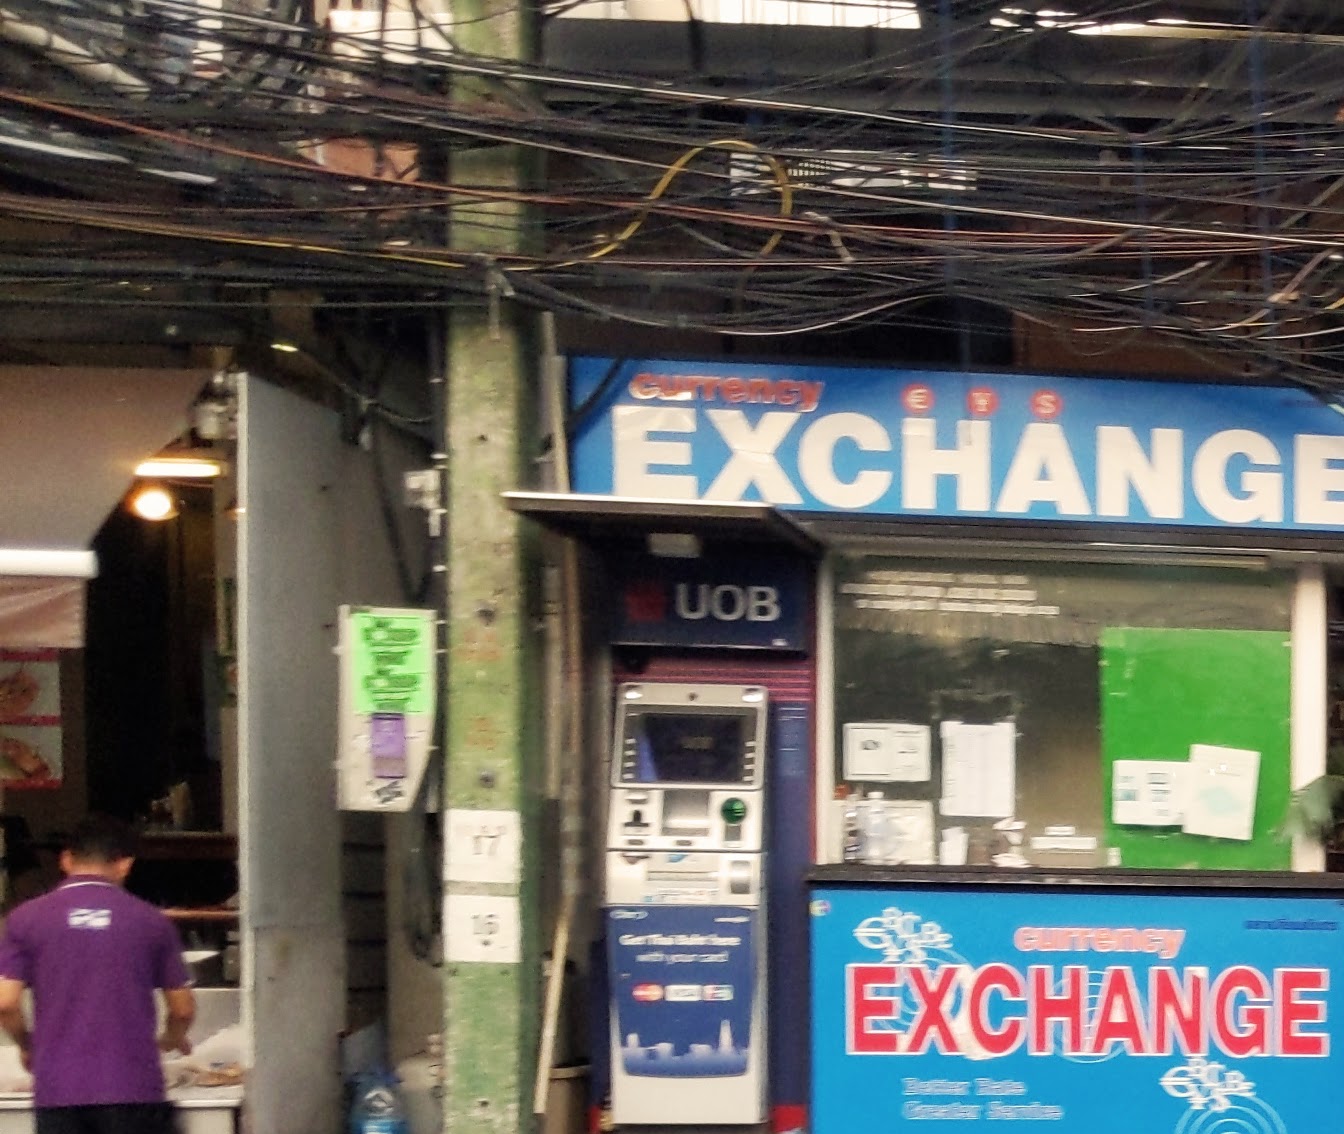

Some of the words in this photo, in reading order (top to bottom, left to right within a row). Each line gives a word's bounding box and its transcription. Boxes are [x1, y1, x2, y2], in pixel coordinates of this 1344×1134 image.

[628, 371, 823, 414] currency
[675, 582, 781, 623] UOB
[1013, 926, 1187, 960] currency
[845, 962, 1331, 1059] EXCHANGE
